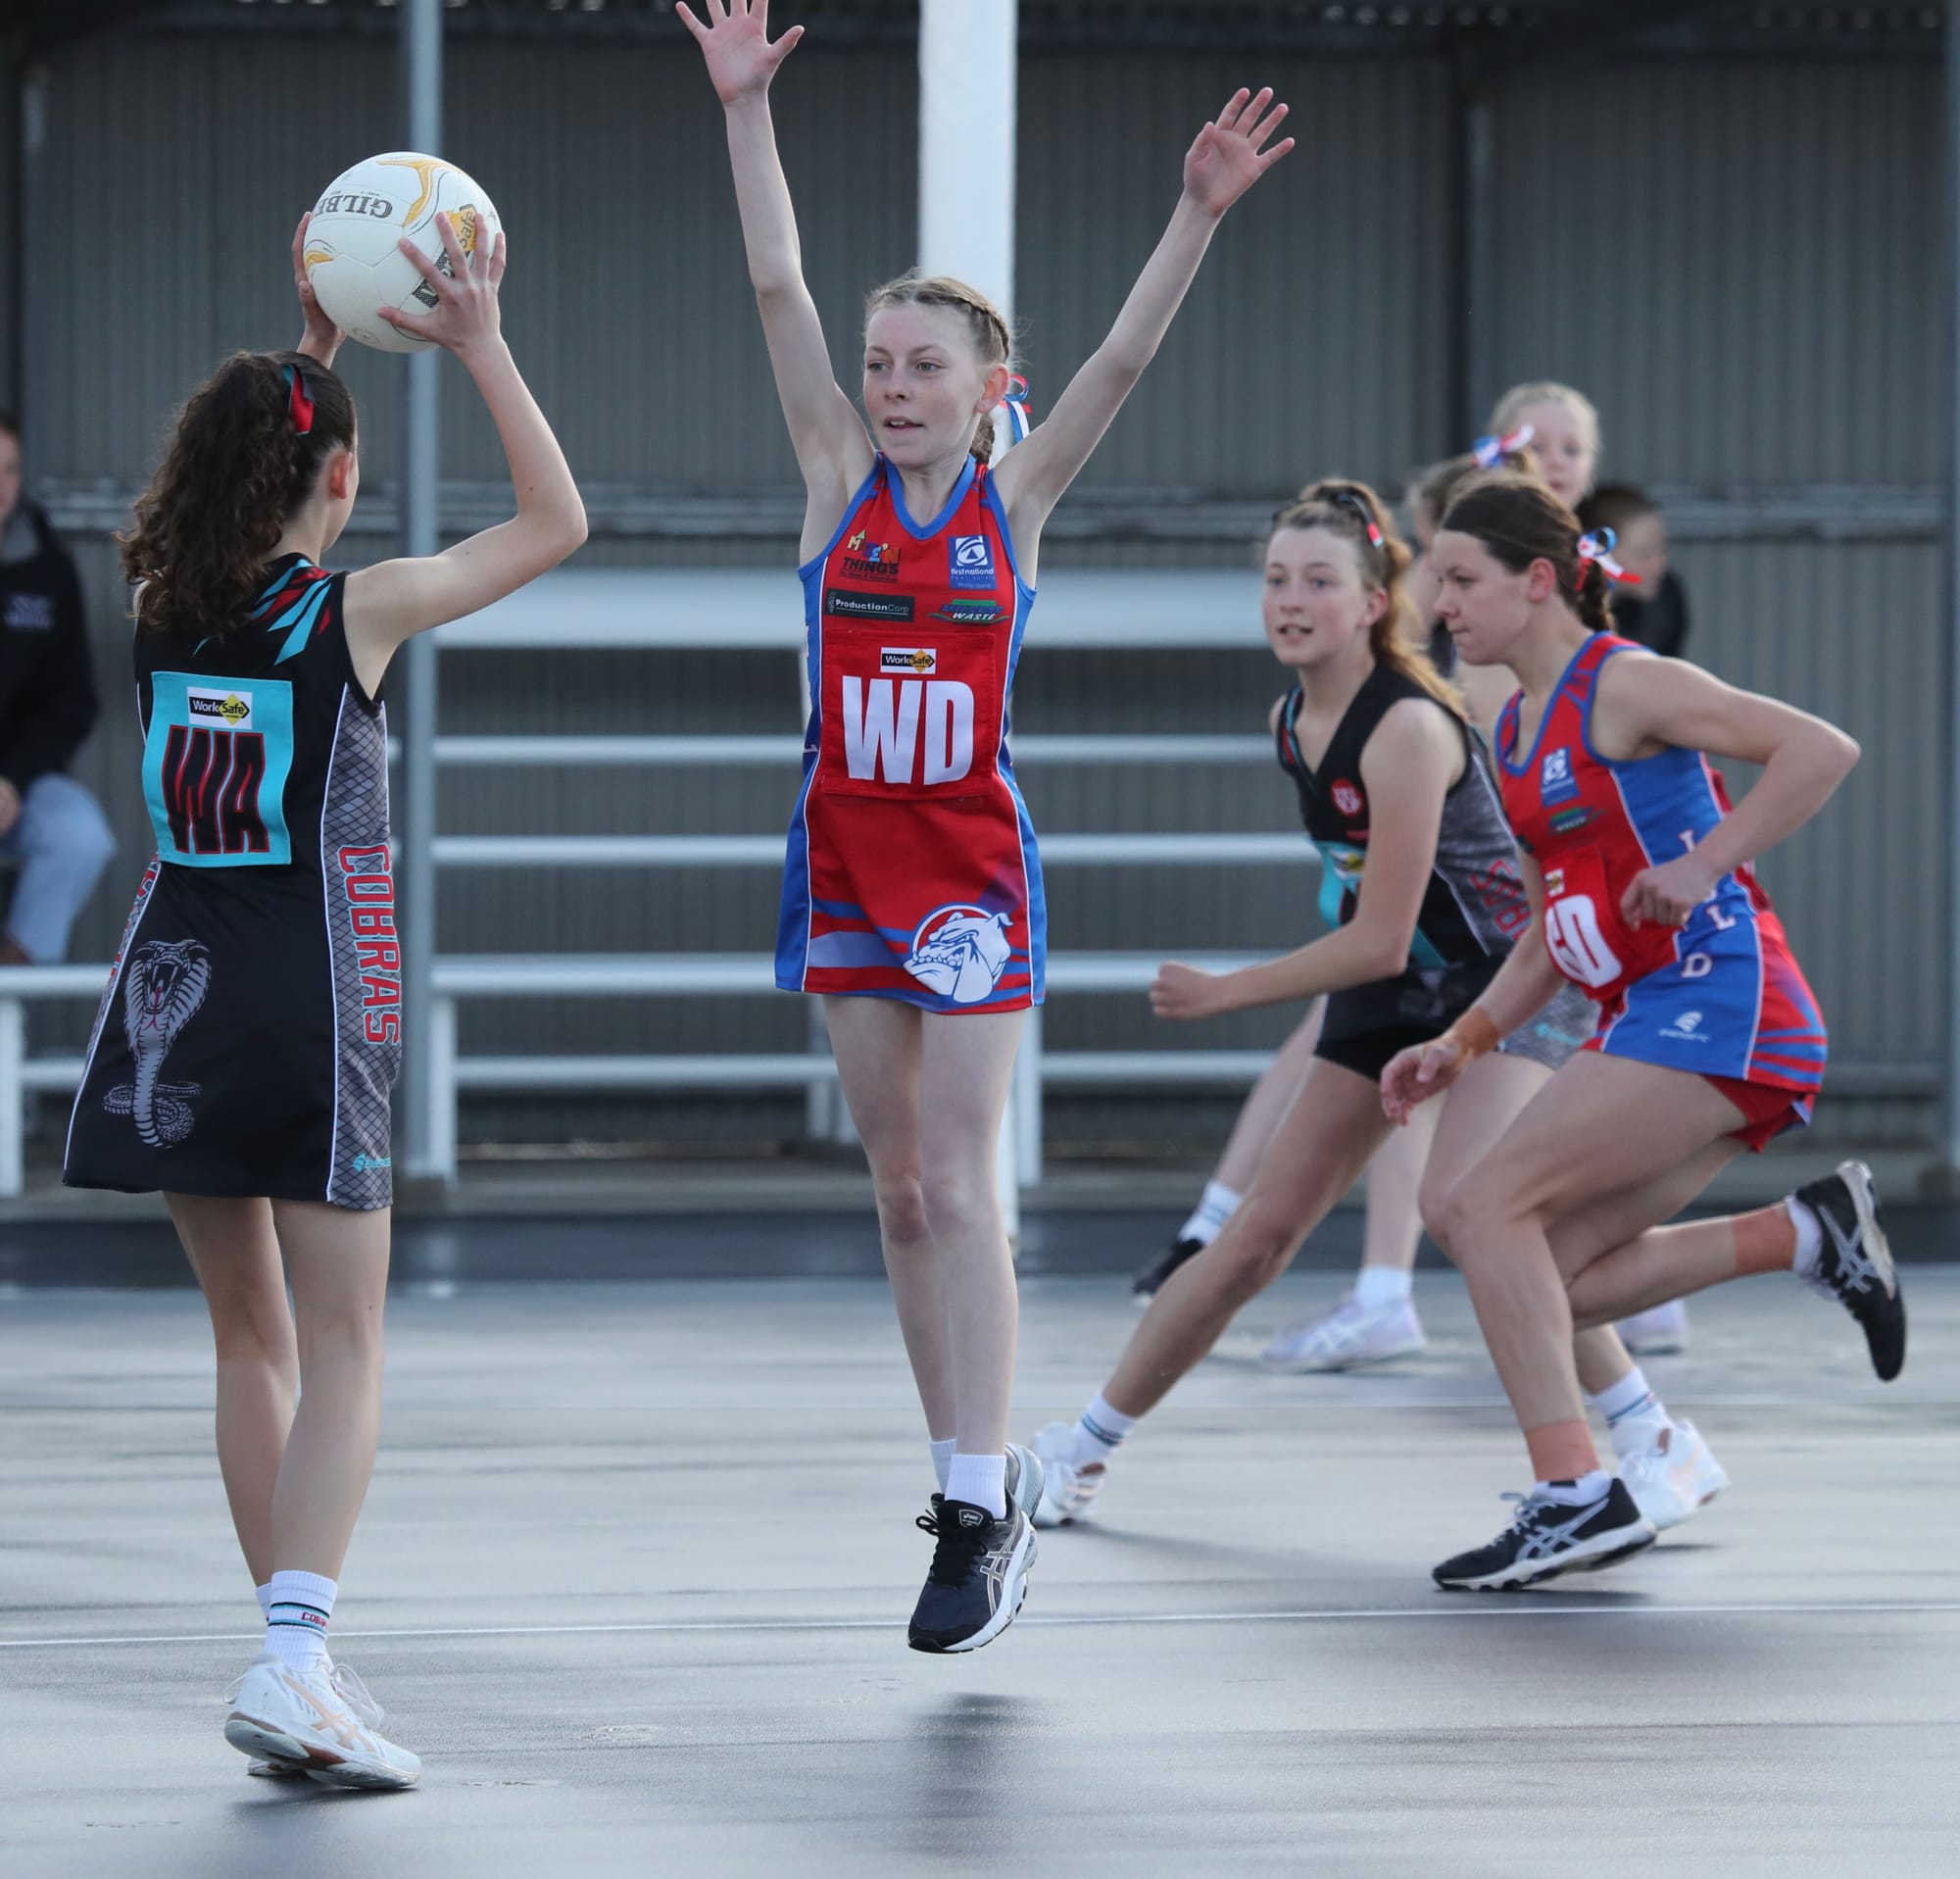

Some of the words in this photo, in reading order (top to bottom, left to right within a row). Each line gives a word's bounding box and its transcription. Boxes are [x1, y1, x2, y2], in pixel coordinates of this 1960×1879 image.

[843, 556, 899, 574] THINGS
[835, 598, 909, 614] ProductionCorp
[952, 612, 997, 620] WASTE
[192, 699, 244, 715] WorkSafe
[842, 674, 975, 786] WD
[162, 724, 270, 854] WA
[337, 844, 401, 1046] COBRAS
